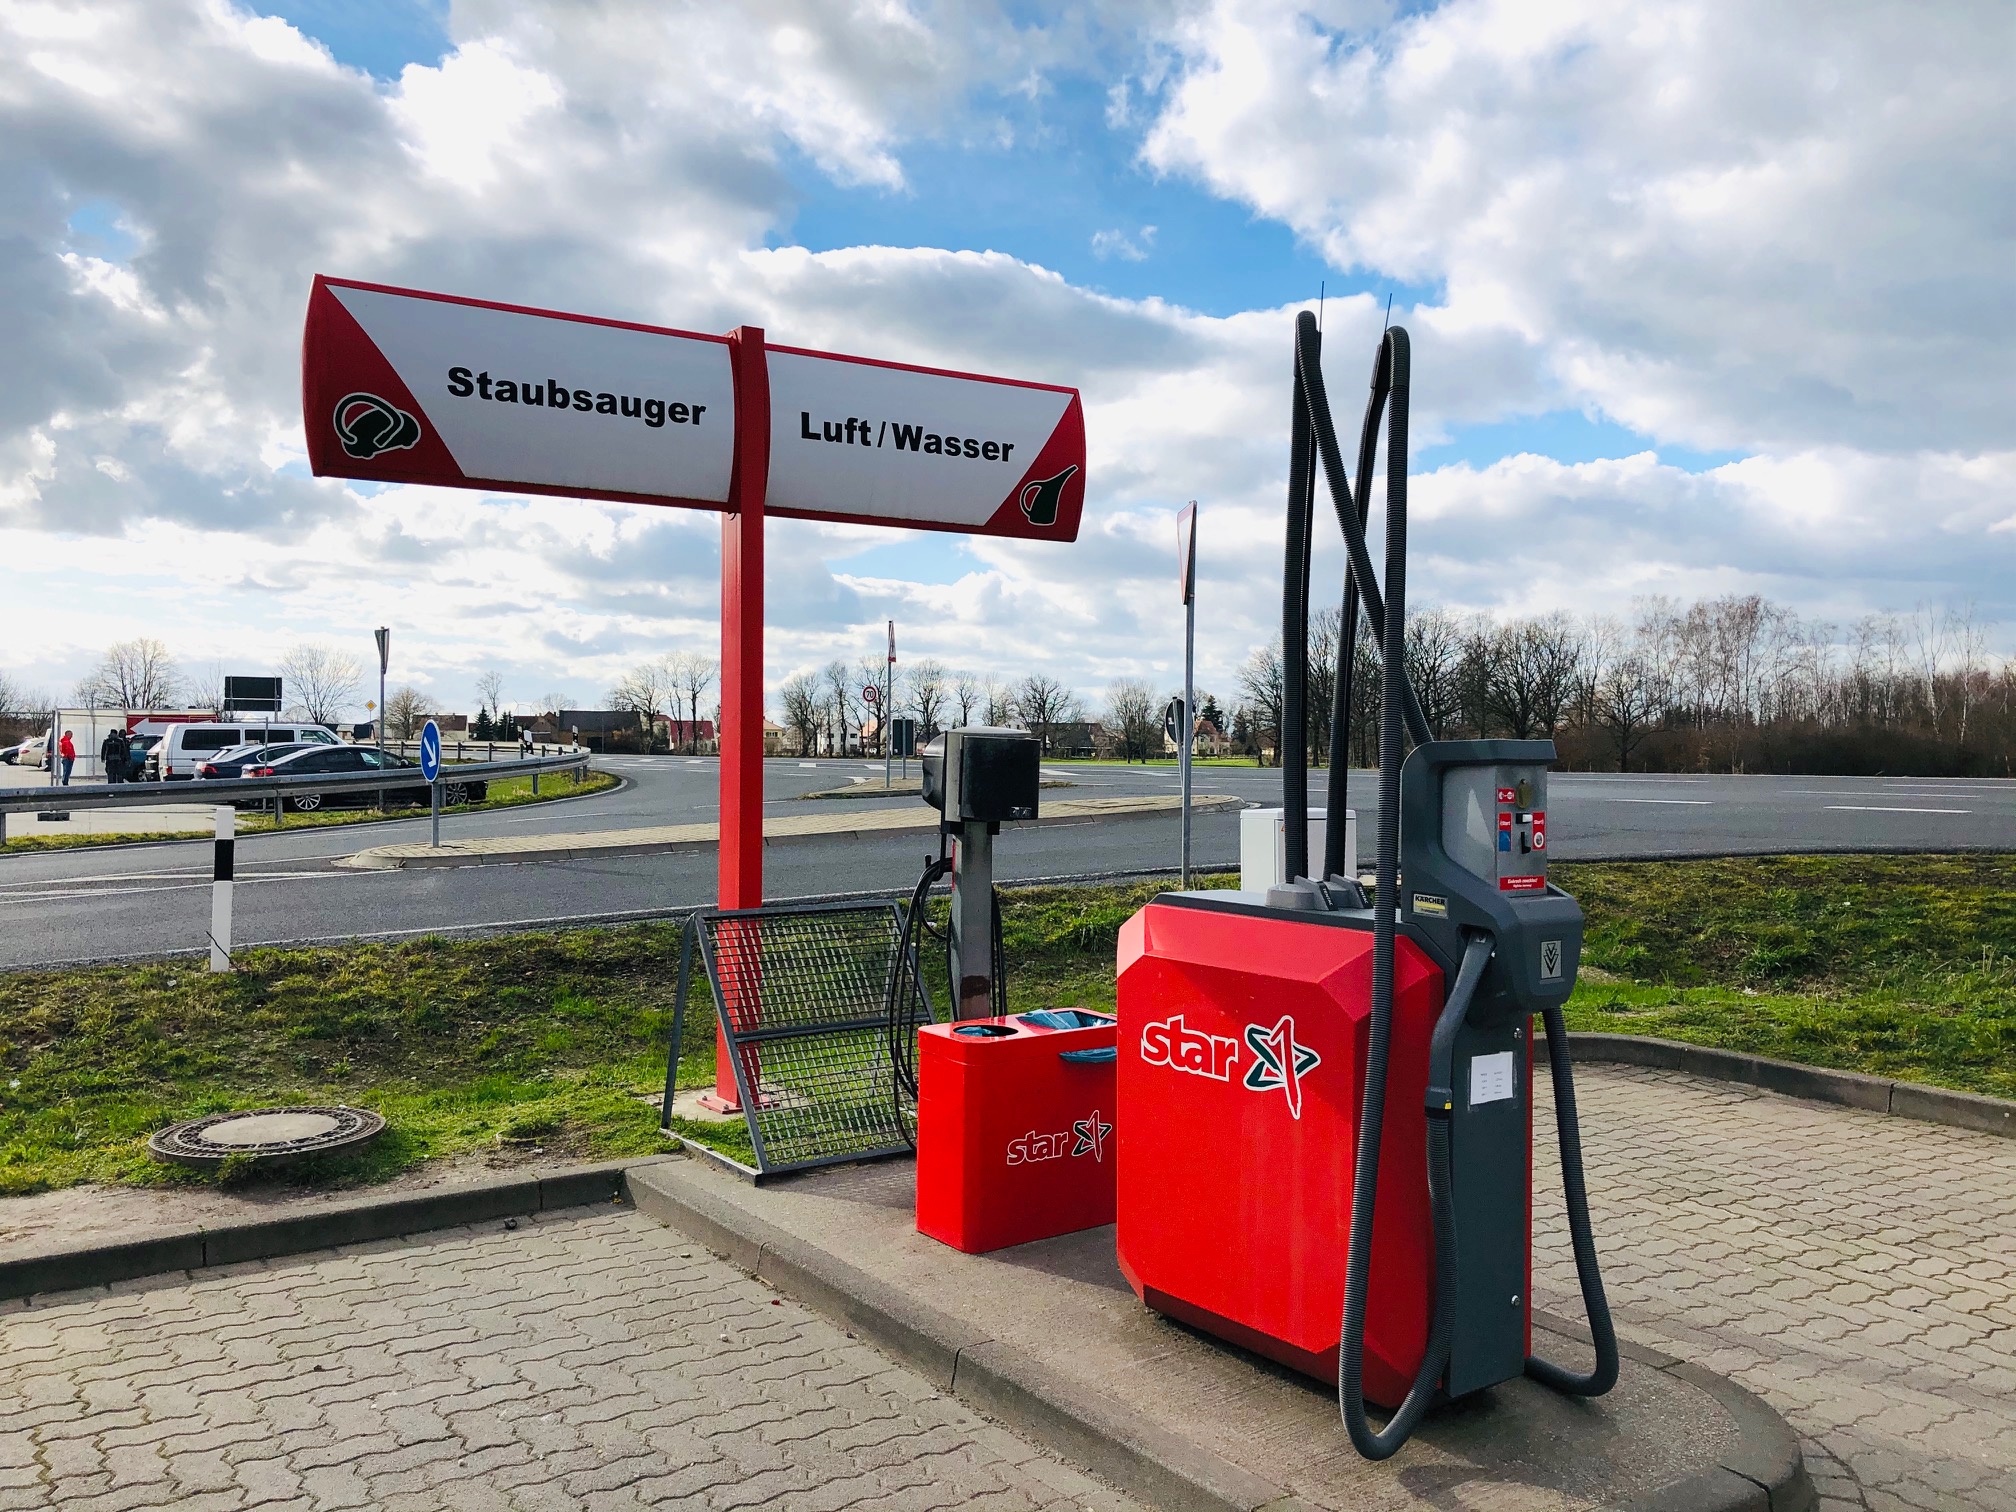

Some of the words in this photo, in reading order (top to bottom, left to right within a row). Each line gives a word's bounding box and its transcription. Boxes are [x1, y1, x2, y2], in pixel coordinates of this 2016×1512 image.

[447, 366, 707, 428] Staubsauger
[867, 690, 874, 698] 70
[1140, 1014, 1239, 1082] star
[1006, 1130, 1069, 1165] star
